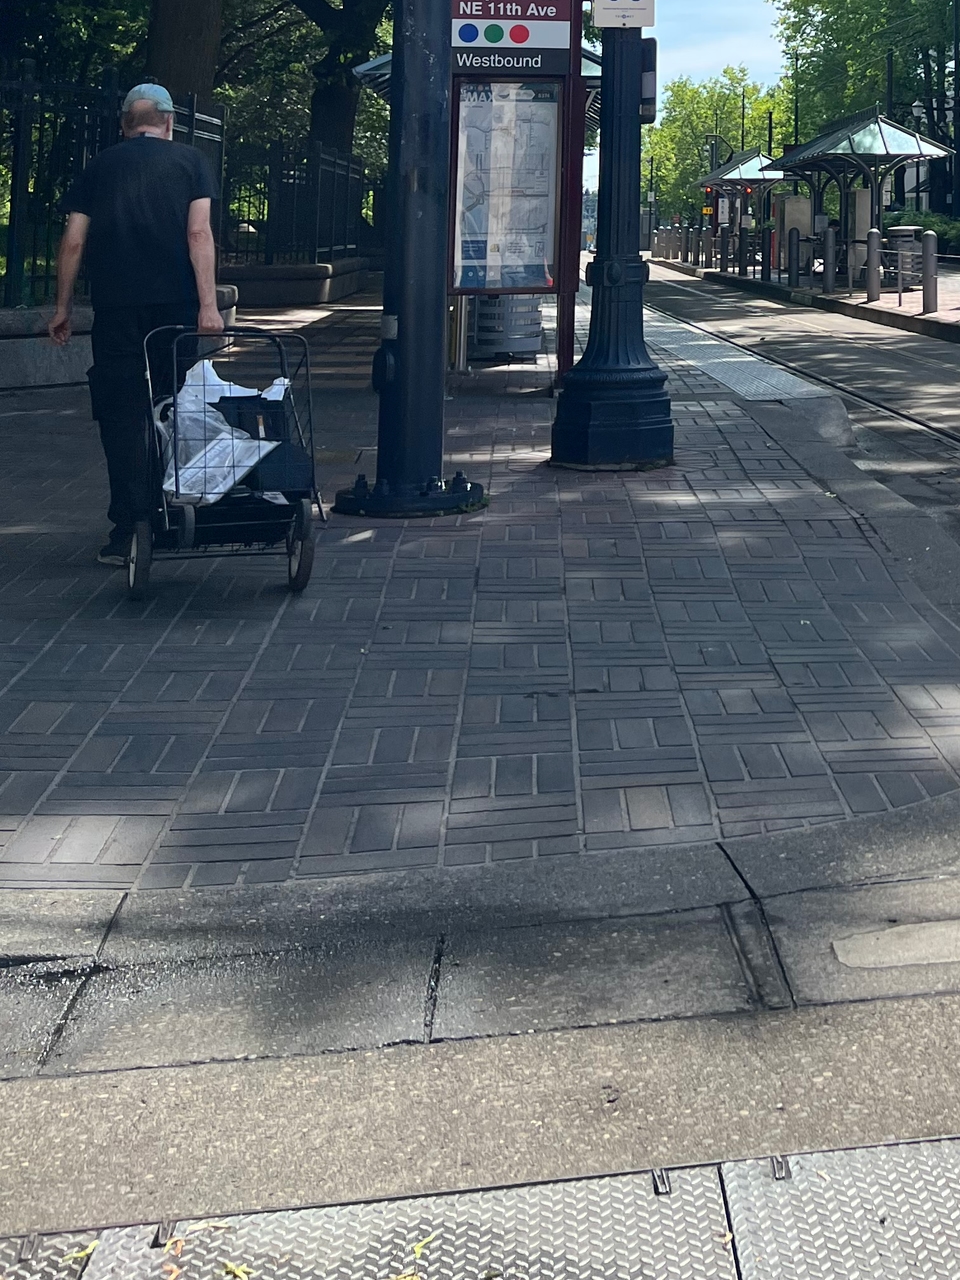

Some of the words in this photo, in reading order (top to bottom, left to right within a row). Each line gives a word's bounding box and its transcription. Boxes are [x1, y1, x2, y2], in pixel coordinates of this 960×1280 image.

[459, 2, 483, 15] NE
[488, 2, 522, 16] 11th
[526, 3, 557, 17] Ave
[456, 52, 542, 68] Westbound
